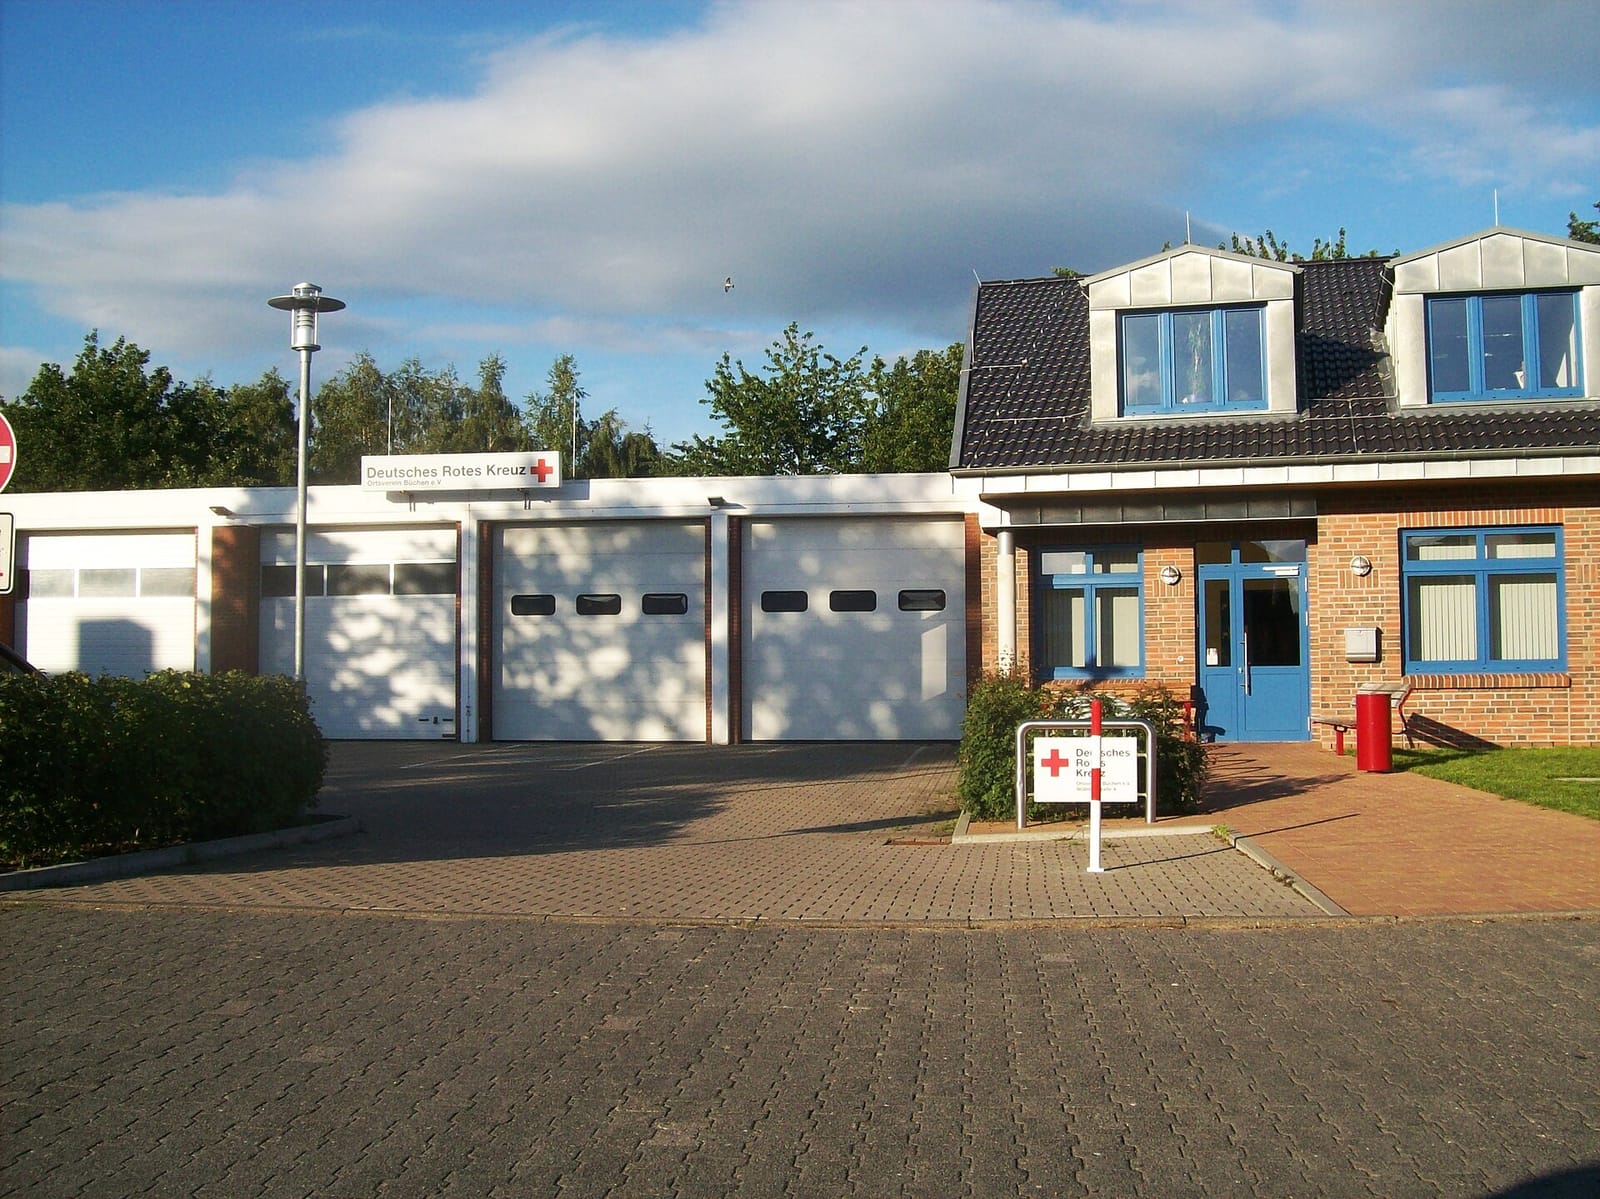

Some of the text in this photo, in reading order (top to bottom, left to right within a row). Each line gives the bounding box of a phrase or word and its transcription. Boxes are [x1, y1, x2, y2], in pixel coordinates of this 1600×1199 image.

[367, 464, 527, 478] Deutsches Rotes Kreuz
[1075, 748, 1131, 758] Desches
[1075, 758, 1106, 768] Ros
[1075, 768, 1106, 777] Krez
